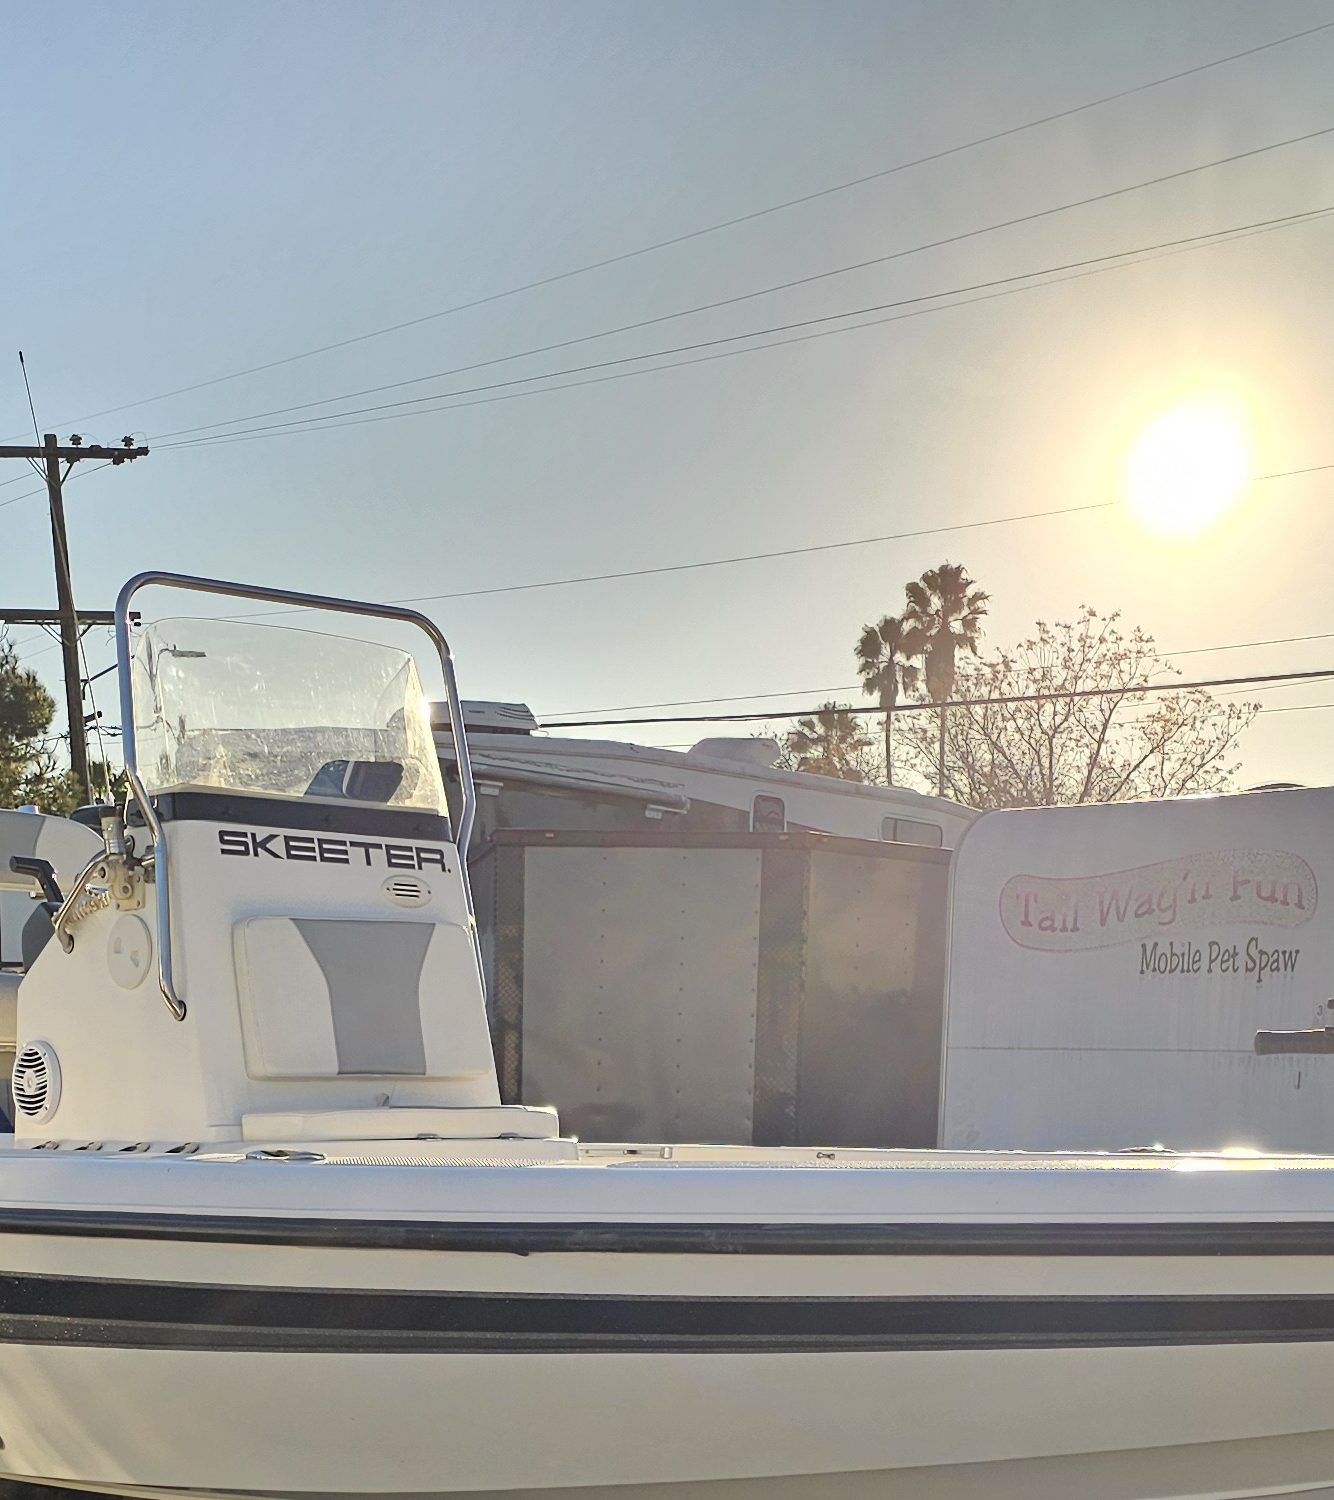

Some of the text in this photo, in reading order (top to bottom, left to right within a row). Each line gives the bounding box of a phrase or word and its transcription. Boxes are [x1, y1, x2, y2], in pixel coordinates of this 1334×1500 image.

[218, 829, 448, 874] SKEETER
[1229, 869, 1307, 911] Fun
[1139, 936, 1301, 983] Mobile Pet Spaw
